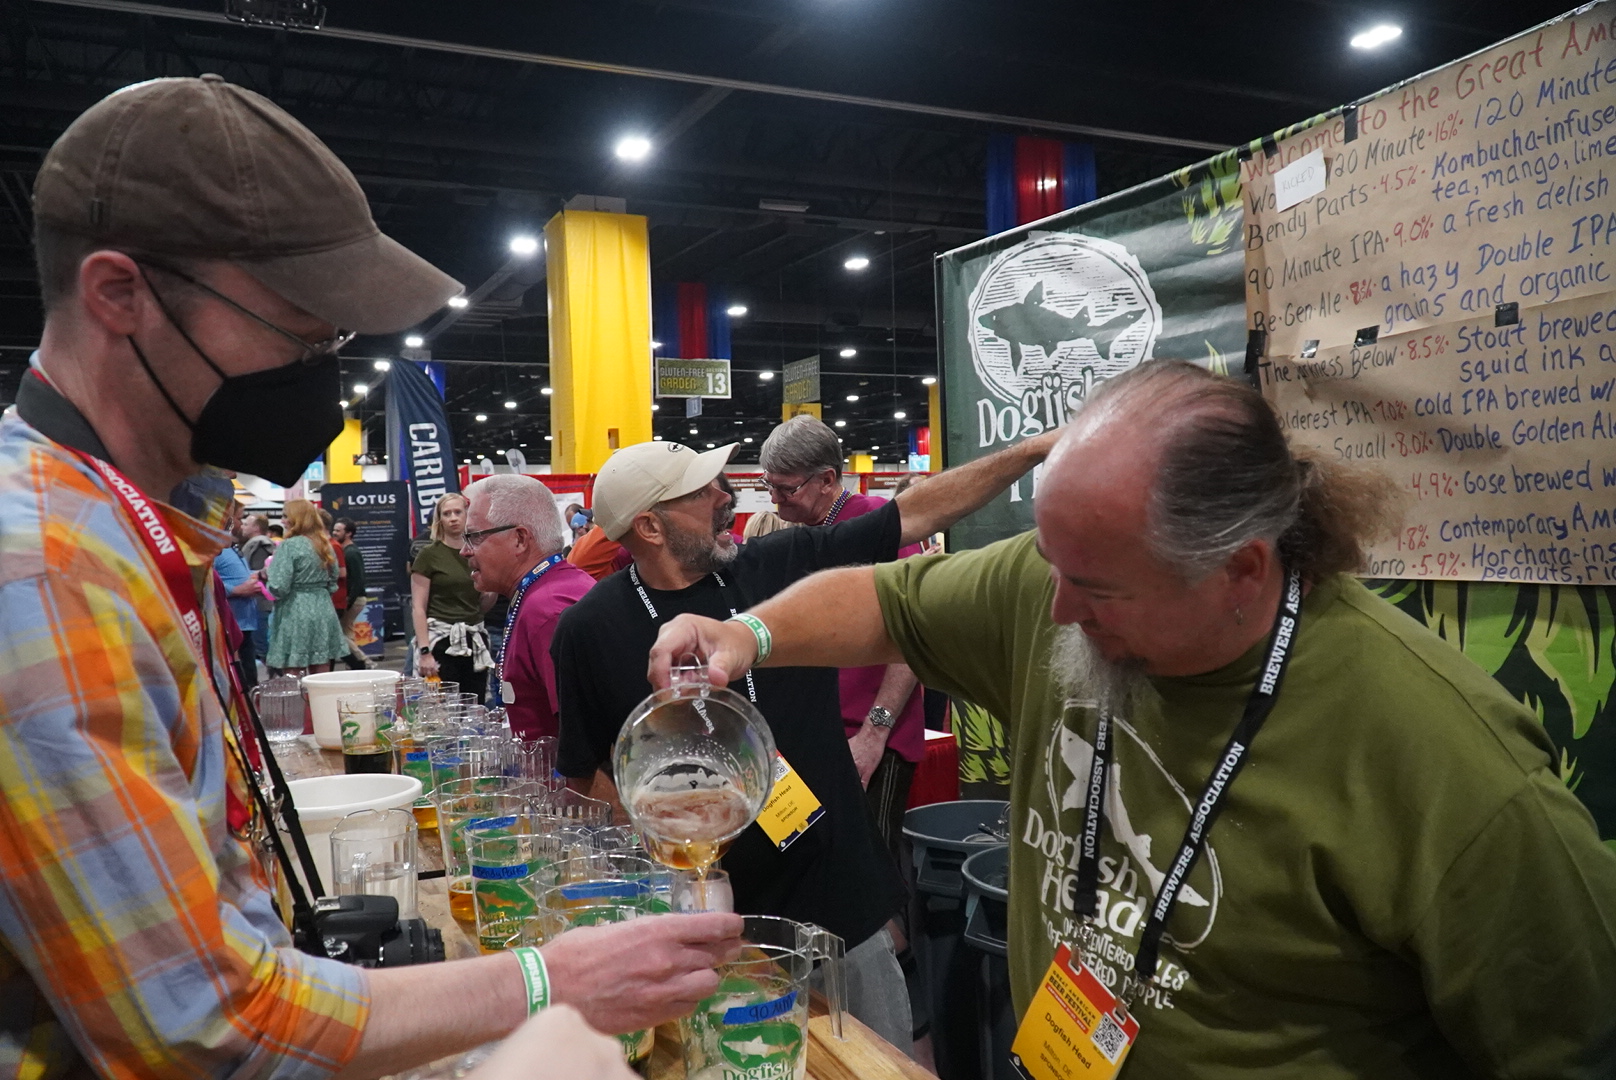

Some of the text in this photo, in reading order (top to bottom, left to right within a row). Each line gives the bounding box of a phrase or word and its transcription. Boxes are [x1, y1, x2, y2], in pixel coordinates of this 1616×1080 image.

[1245, 118, 1344, 182] Welcome
[1357, 103, 1387, 135] to
[1399, 86, 1440, 122] the
[1456, 32, 1544, 100] Great
[1364, 126, 1426, 170] Minute
[1434, 110, 1460, 143] 16%
[1474, 90, 1525, 129] 120
[1536, 57, 1616, 109] Minute
[1248, 105, 1616, 252] Bendy Parts 4.5% Kombucha-infuse
[1281, 166, 1316, 193] KICKED
[1432, 135, 1616, 202] tea, mango, lime
[1248, 169, 1609, 295] 90 Minute IPA 9.0% a fresh delish
[1381, 275, 1392, 292] a
[1400, 260, 1459, 293] hazy
[1475, 229, 1554, 275] Double
[1568, 212, 1616, 254] IPA
[1384, 253, 1611, 333] grains and organic
[660, 367, 705, 378] GLUTEN-FREE
[1260, 360, 1292, 385] The
[1297, 356, 1344, 381] arkness
[1350, 345, 1398, 379] Below
[1407, 334, 1445, 360] 8.5%
[1456, 318, 1527, 354] Stout
[1459, 347, 1529, 383] squid
[1541, 343, 1586, 371] ink
[660, 377, 697, 390] GARDEN
[706, 373, 727, 394] 13
[1278, 402, 1338, 431] olderest
[1343, 400, 1375, 426] IPA
[1414, 391, 1453, 417] cold
[1462, 387, 1499, 416] IPA
[1504, 375, 1581, 411] brewed
[1334, 409, 1616, 462] Squall 8.0% Double Golden Al
[347, 494, 397, 506] LOTUS
[1411, 472, 1454, 500] 4.9%
[1463, 470, 1507, 495] Gose
[1510, 459, 1594, 493] brewed
[1439, 512, 1569, 543] Contemporary
[1572, 501, 1616, 532] Am
[1417, 551, 1461, 577] 5.9%
[636, 586, 659, 619] BREWERS
[1259, 615, 1296, 696] BREWERS
[762, 785, 793, 813] Dogfish Head
[780, 806, 799, 823] SPONSOR
[1084, 755, 1104, 860] ASSOCIATION
[1022, 807, 1139, 900] Dogfsh
[1154, 741, 1246, 922] BREWERS ASSOCIATION
[522, 952, 544, 1005] Thursday
[1048, 975, 1093, 1027] BEER FESTIVAL
[1052, 970, 1097, 1020] GREAT AMERICAN
[749, 1004, 769, 1021] 90
[1039, 1053, 1066, 1080] SPONSO
[1044, 1012, 1093, 1070] Dogfish Head
[1062, 1063, 1074, 1078] DE
